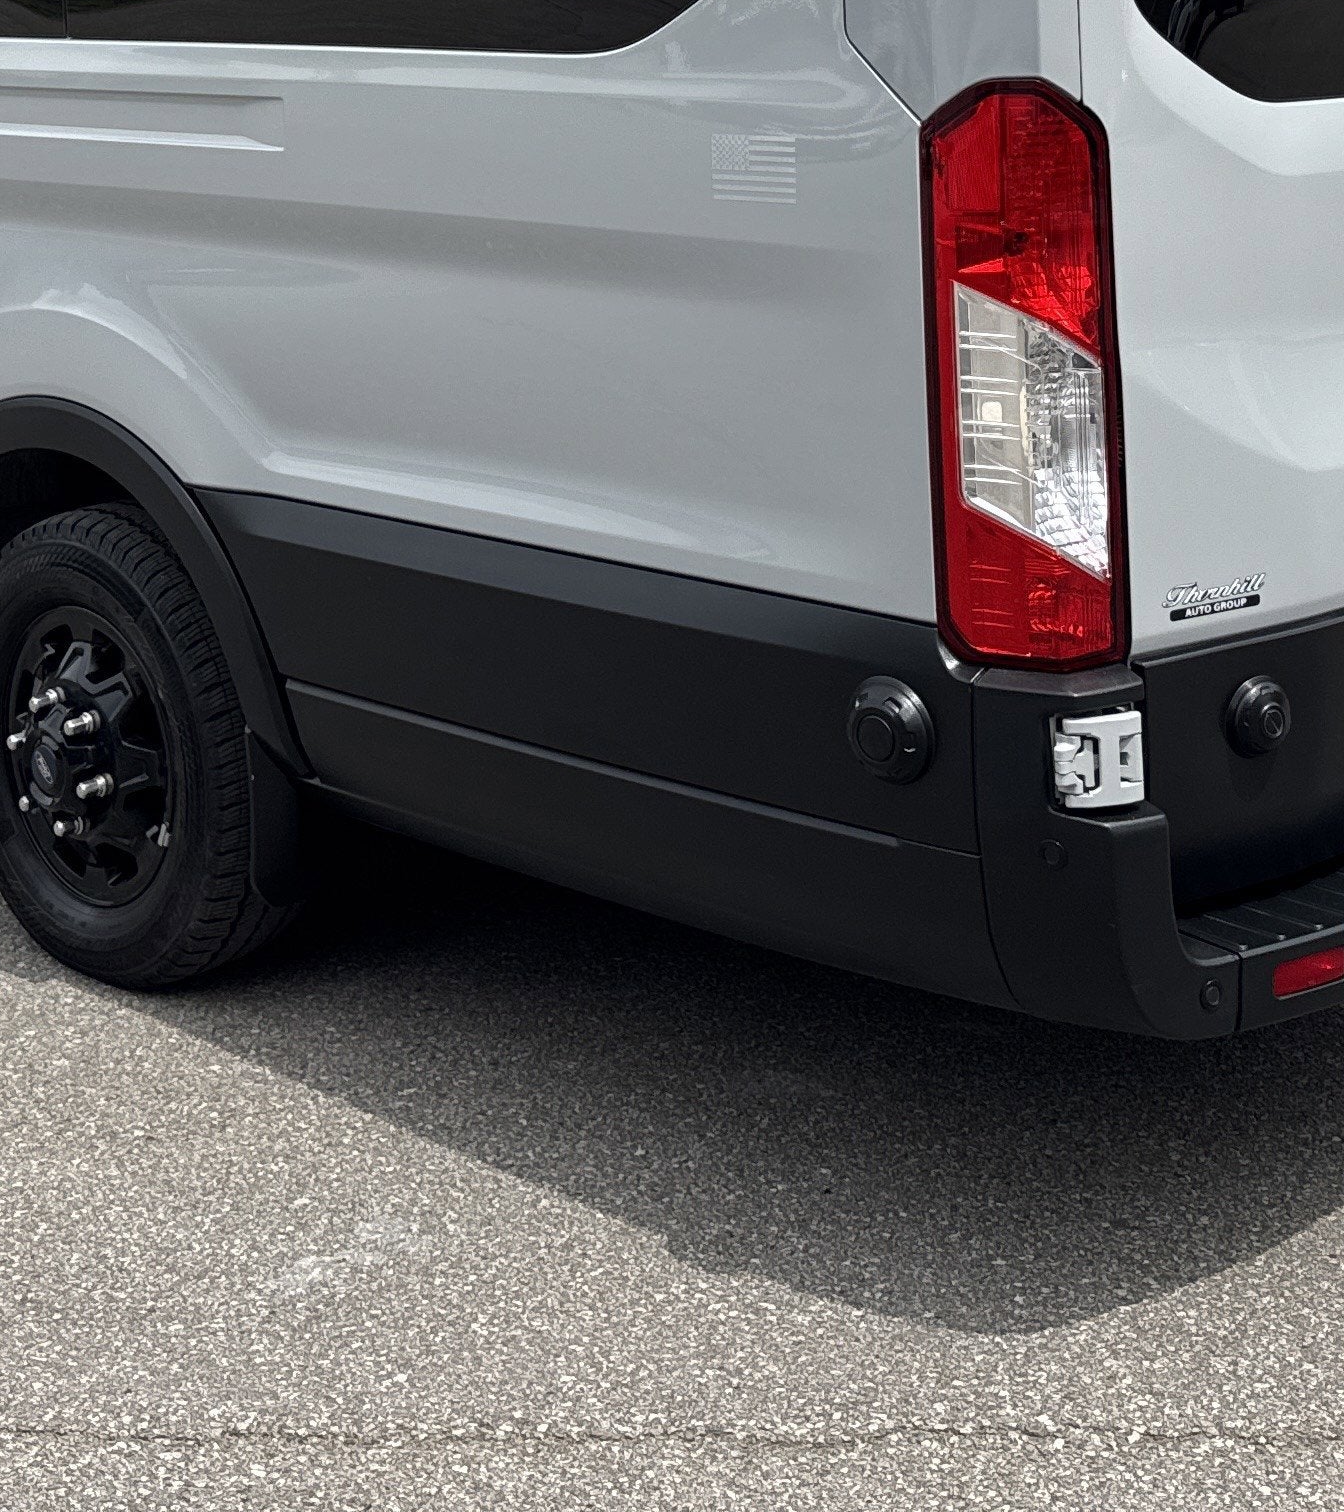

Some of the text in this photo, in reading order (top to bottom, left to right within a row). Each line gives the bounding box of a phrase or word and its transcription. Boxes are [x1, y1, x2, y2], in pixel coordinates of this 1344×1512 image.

[1162, 573, 1266, 608] Thornhill
[1184, 597, 1248, 618] AUTO GROUP
